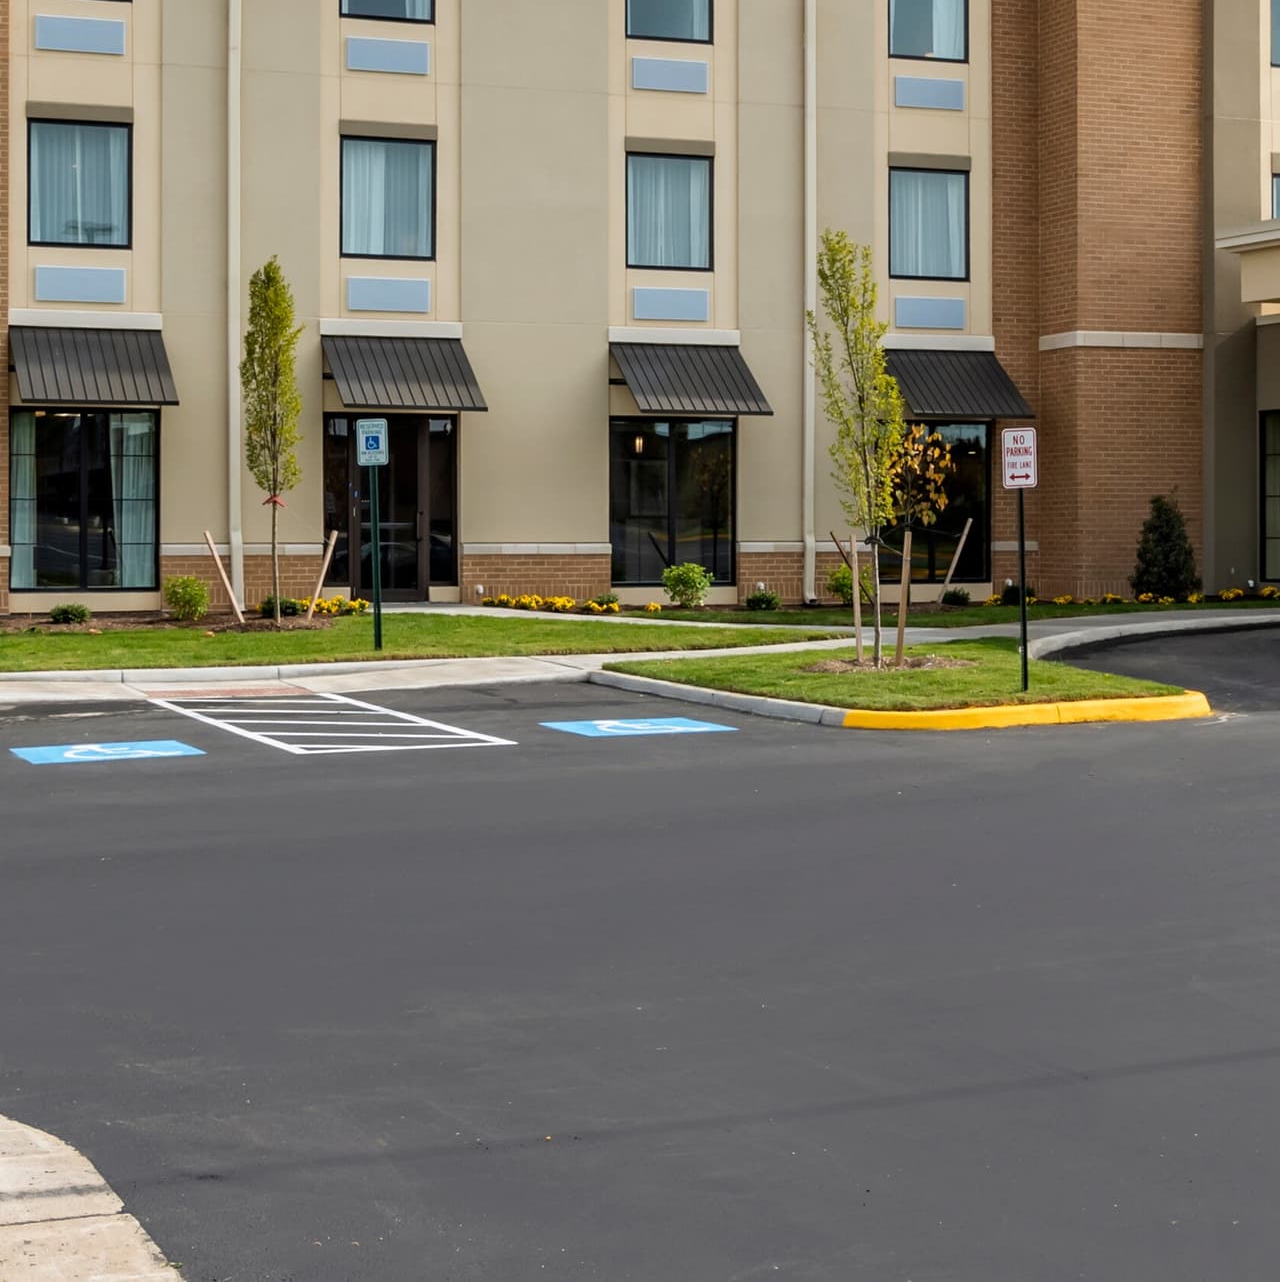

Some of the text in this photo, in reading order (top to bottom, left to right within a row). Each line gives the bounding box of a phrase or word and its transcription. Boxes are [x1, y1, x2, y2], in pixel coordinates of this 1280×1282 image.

[1012, 435, 1025, 445] NO
[1006, 446, 1033, 457] PARKING
[1007, 461, 1032, 470] FIRE LANE
